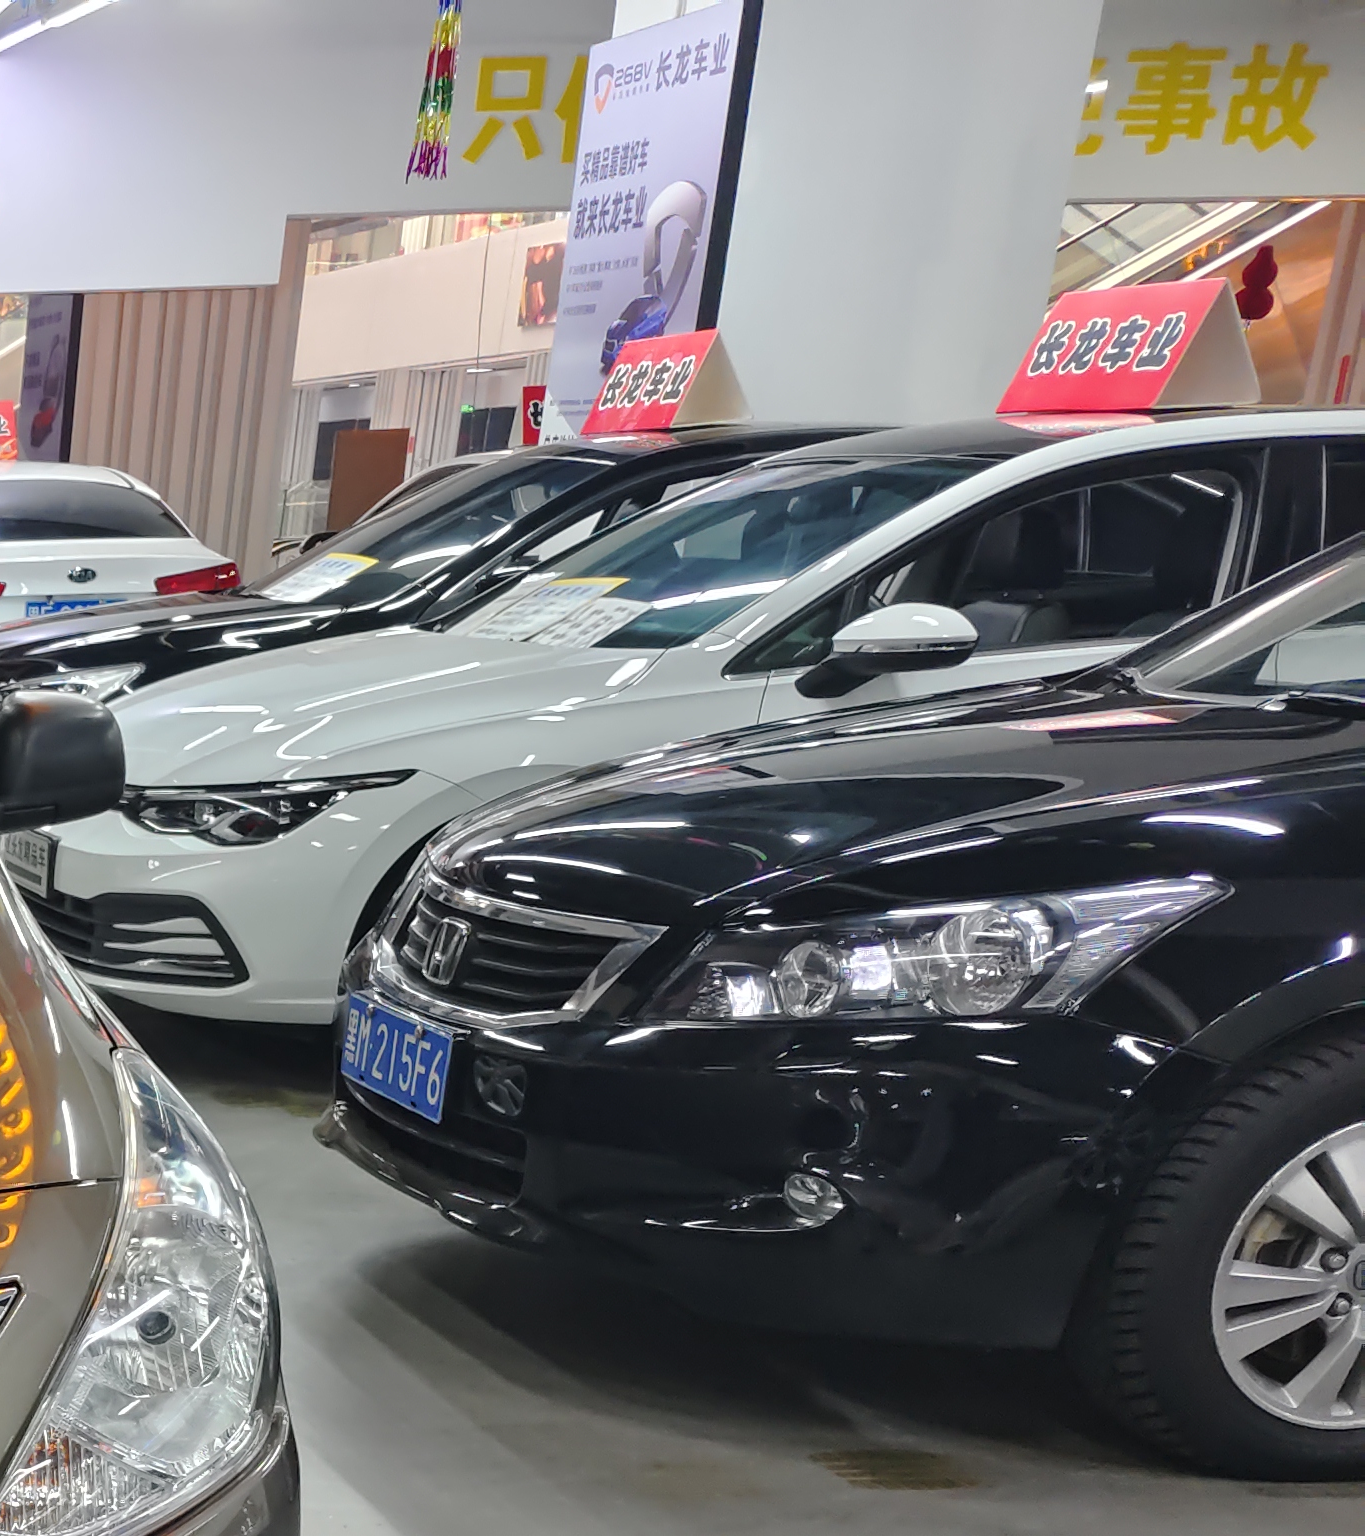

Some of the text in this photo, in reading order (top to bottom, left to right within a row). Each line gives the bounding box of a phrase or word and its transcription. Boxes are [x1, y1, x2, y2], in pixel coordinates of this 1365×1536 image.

[655, 32, 731, 92] 长龙车业
[573, 186, 648, 240] 就来长龙车业
[1027, 311, 1186, 377] 长龙车业
[598, 355, 697, 412] 长龙车业
